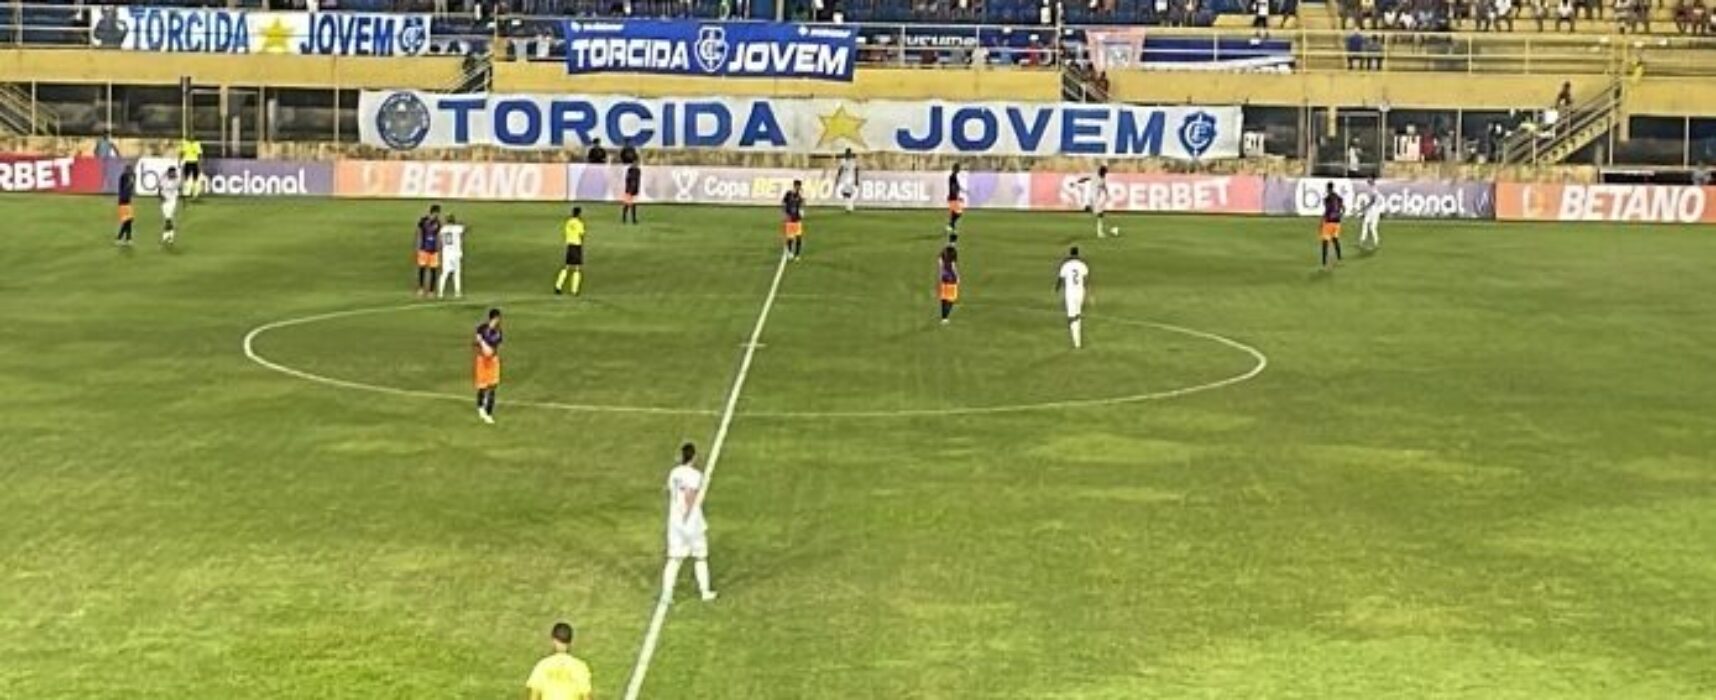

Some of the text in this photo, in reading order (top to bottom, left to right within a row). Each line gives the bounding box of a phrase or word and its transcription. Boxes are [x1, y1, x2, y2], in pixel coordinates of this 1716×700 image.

[129, 6, 250, 53] TORCIDA
[301, 13, 395, 56] JOVEM
[571, 39, 690, 70] TORCIDA
[728, 42, 849, 75] JOVEM
[437, 100, 787, 147] TORCIDA
[896, 106, 1166, 155] JOVEM
[401, 163, 542, 198] BETANO
[704, 175, 749, 198] Copa
[751, 176, 833, 200] BETNO
[863, 180, 930, 200] BRASIL
[1060, 175, 1231, 209] SPERBET
[1558, 185, 1706, 222] BETANO
